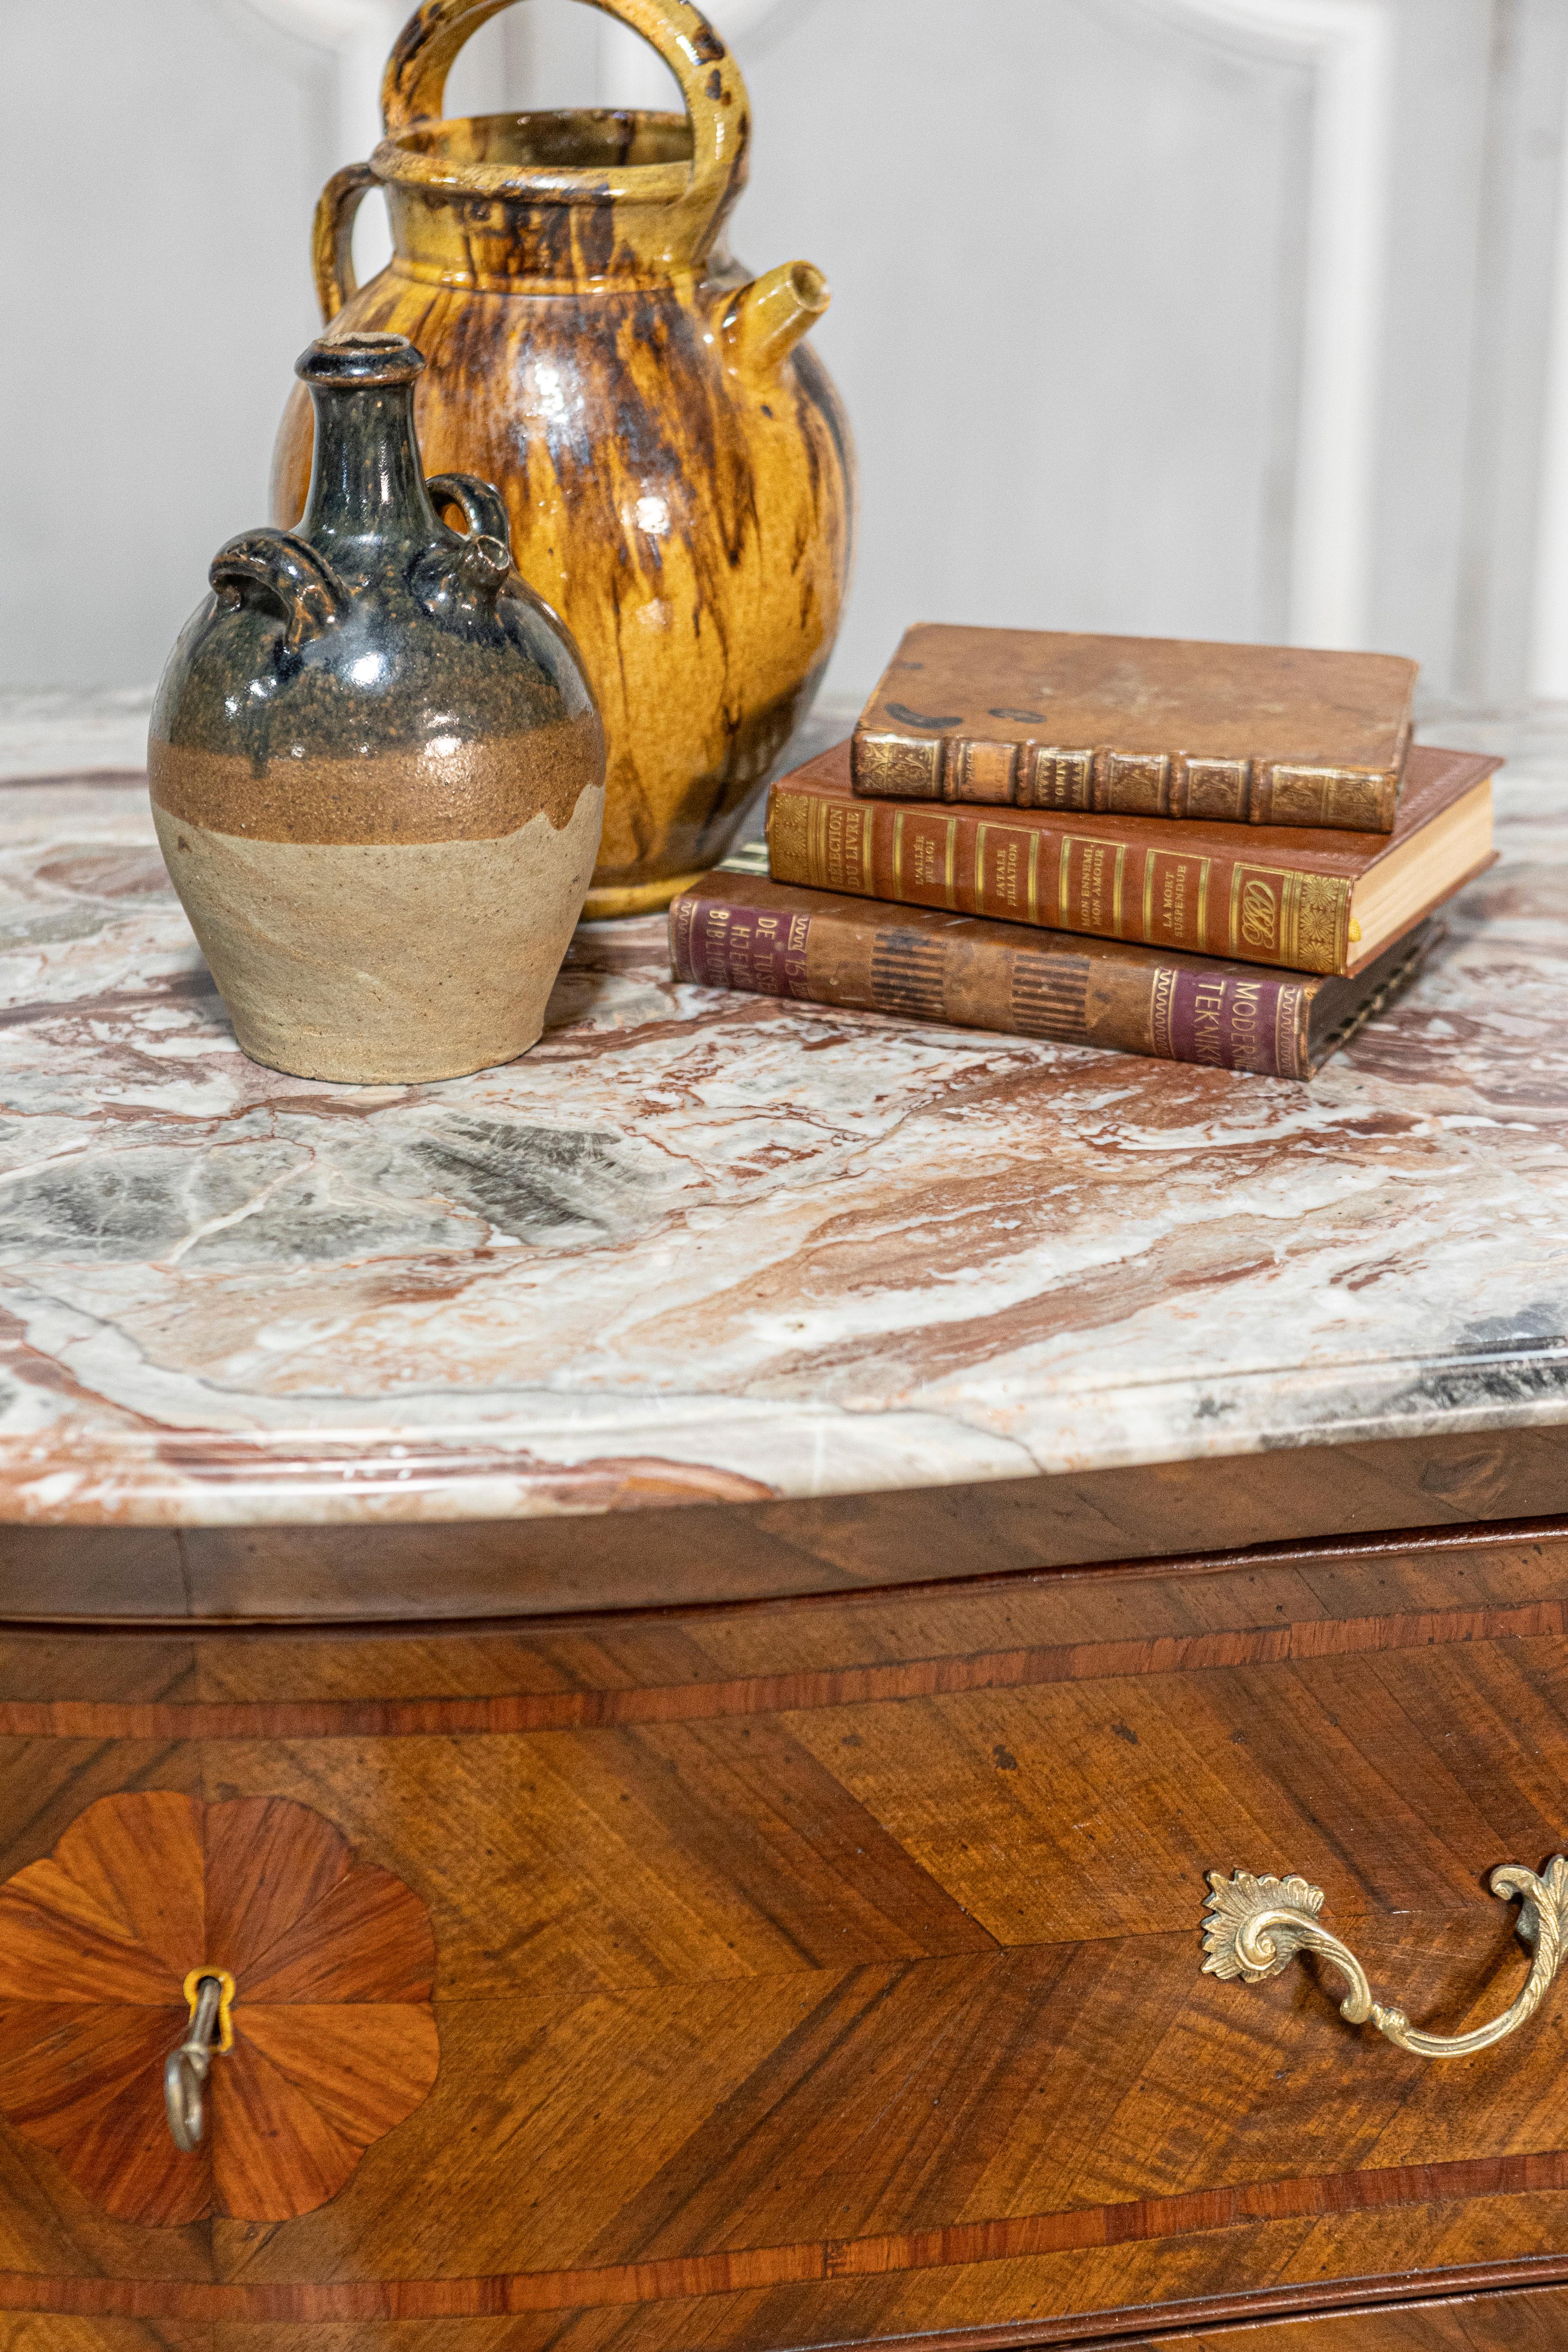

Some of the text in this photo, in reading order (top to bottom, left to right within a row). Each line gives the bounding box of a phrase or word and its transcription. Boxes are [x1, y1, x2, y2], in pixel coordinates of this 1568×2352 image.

[828, 809, 842, 883] SÉLECTION
[845, 812, 859, 887] DU LIVRE
[925, 840, 934, 883] DU ROI
[996, 850, 1006, 897] FATALE
[1007, 843, 1017, 906] FILIATION
[1081, 901, 1090, 927] MON
[1092, 849, 1103, 926] MON AMOUR
[1163, 871, 1174, 928] LA MORT
[1174, 865, 1186, 937] SUSPENDUE
[705, 910, 730, 987] BIBLIOTE
[755, 917, 778, 940] DE
[784, 959, 805, 976] 15
